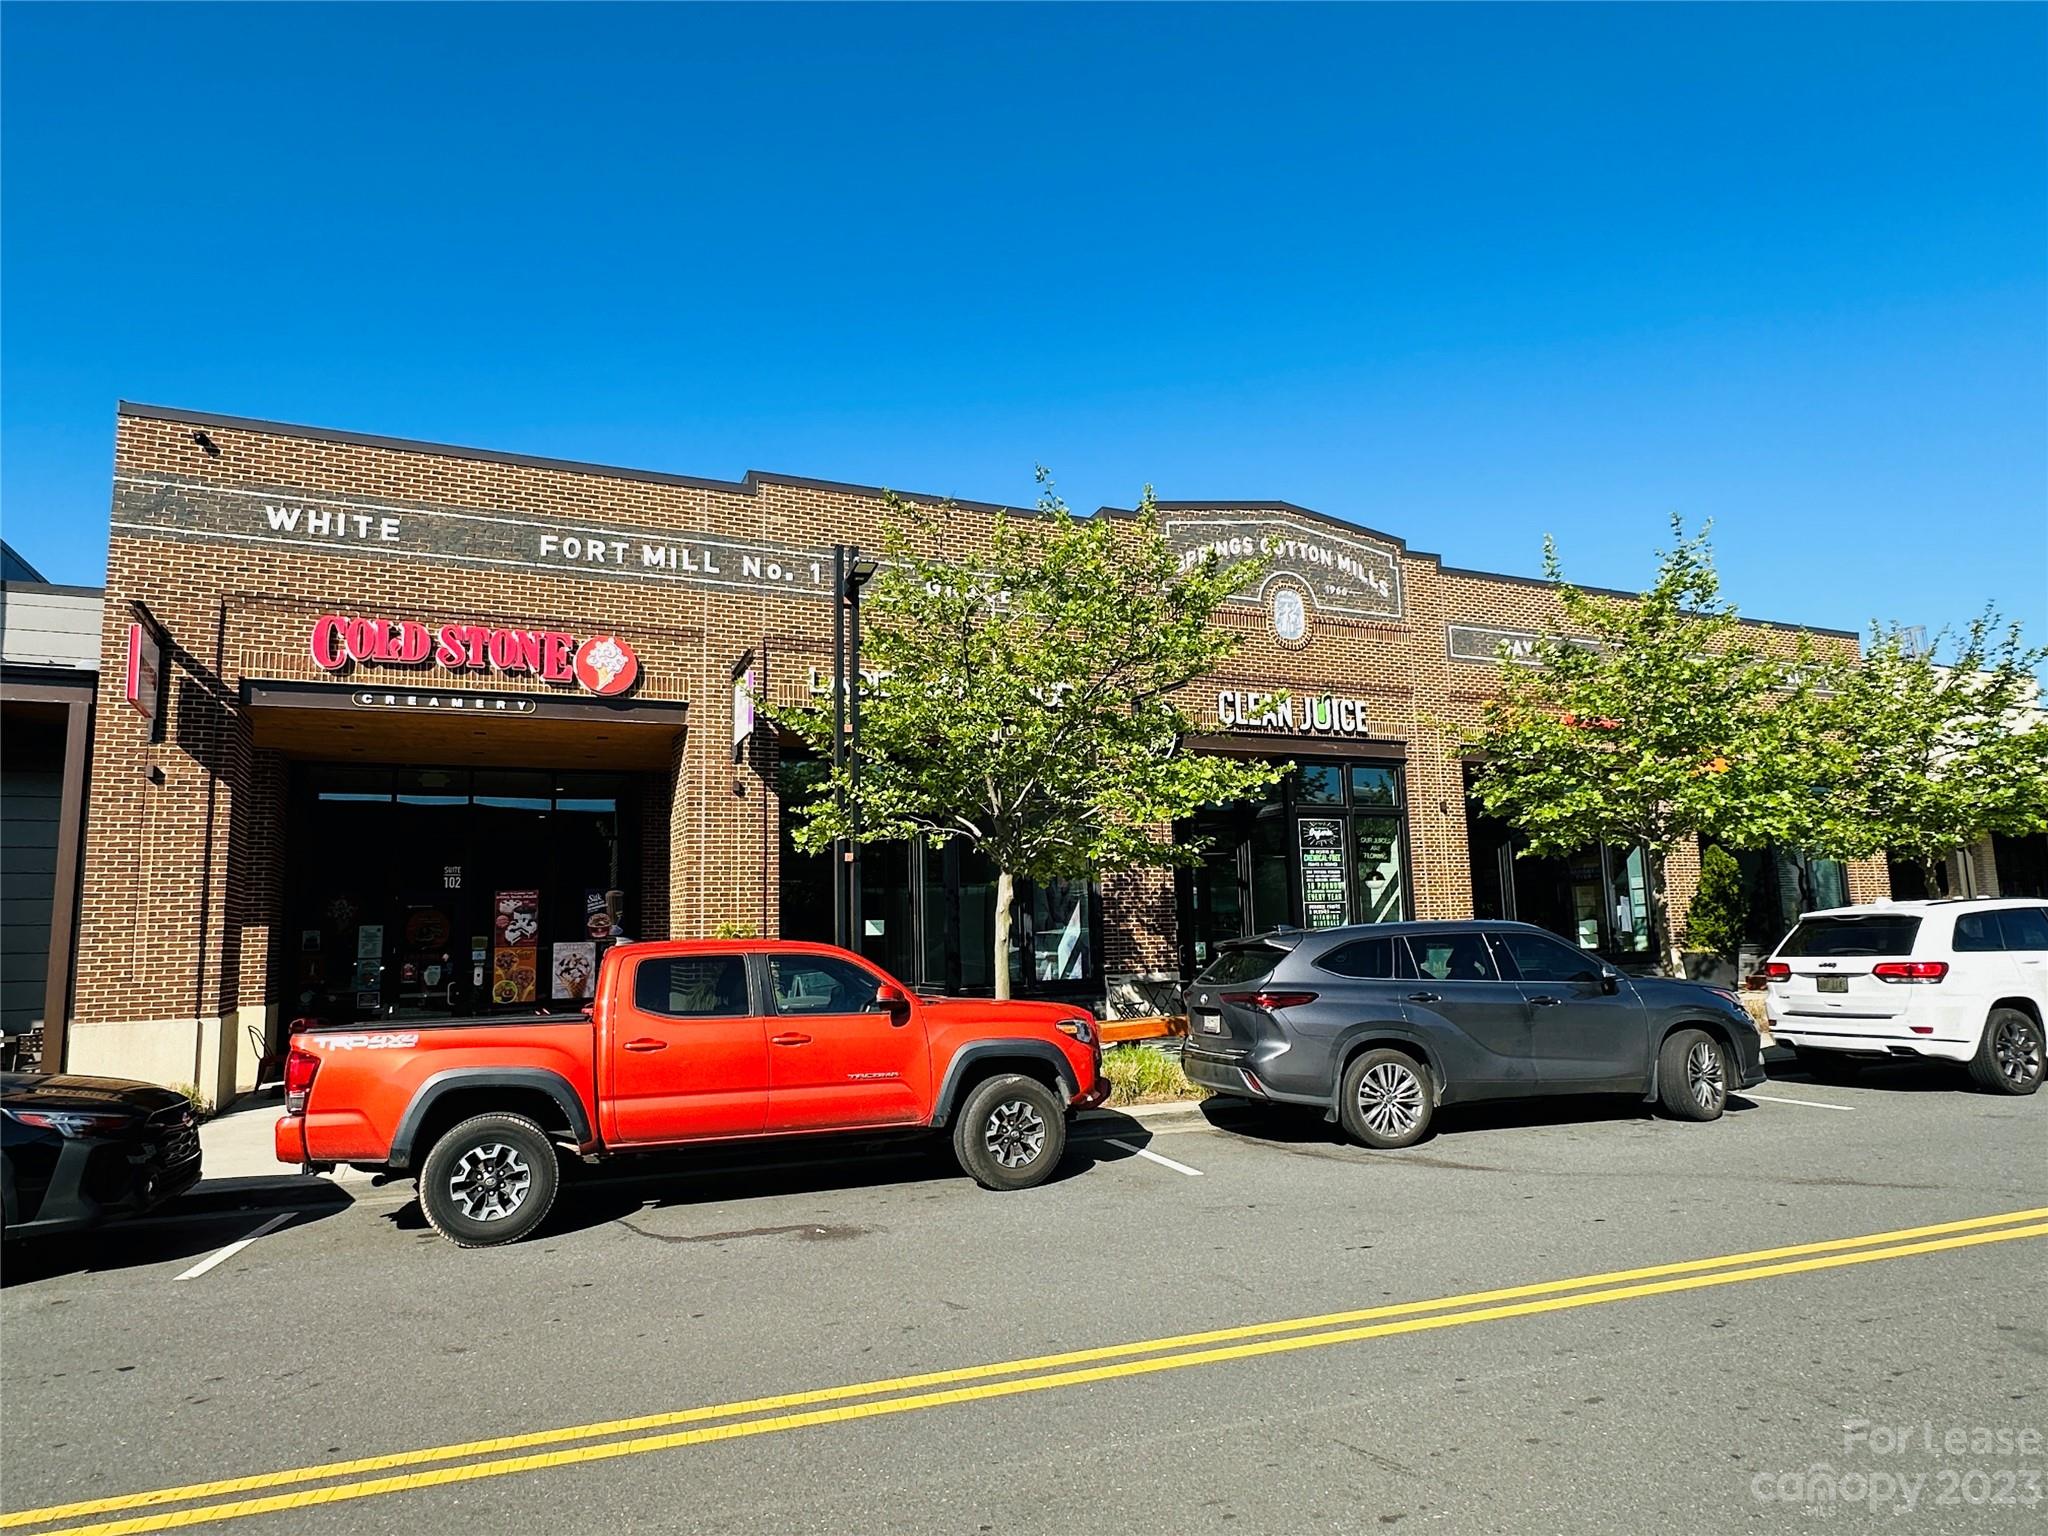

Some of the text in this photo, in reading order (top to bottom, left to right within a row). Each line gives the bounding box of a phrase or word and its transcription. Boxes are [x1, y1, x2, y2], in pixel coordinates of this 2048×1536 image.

[265, 505, 400, 542] WHITE
[540, 534, 821, 584] FORT MILL No. 1
[1338, 553, 1389, 597] MILLS
[310, 614, 574, 683] COLD STONE
[362, 692, 528, 711] CREAMERY
[1218, 690, 1369, 733] CLEAN JUICE
[443, 877, 461, 888] 102
[314, 1035, 368, 1051] TRD
